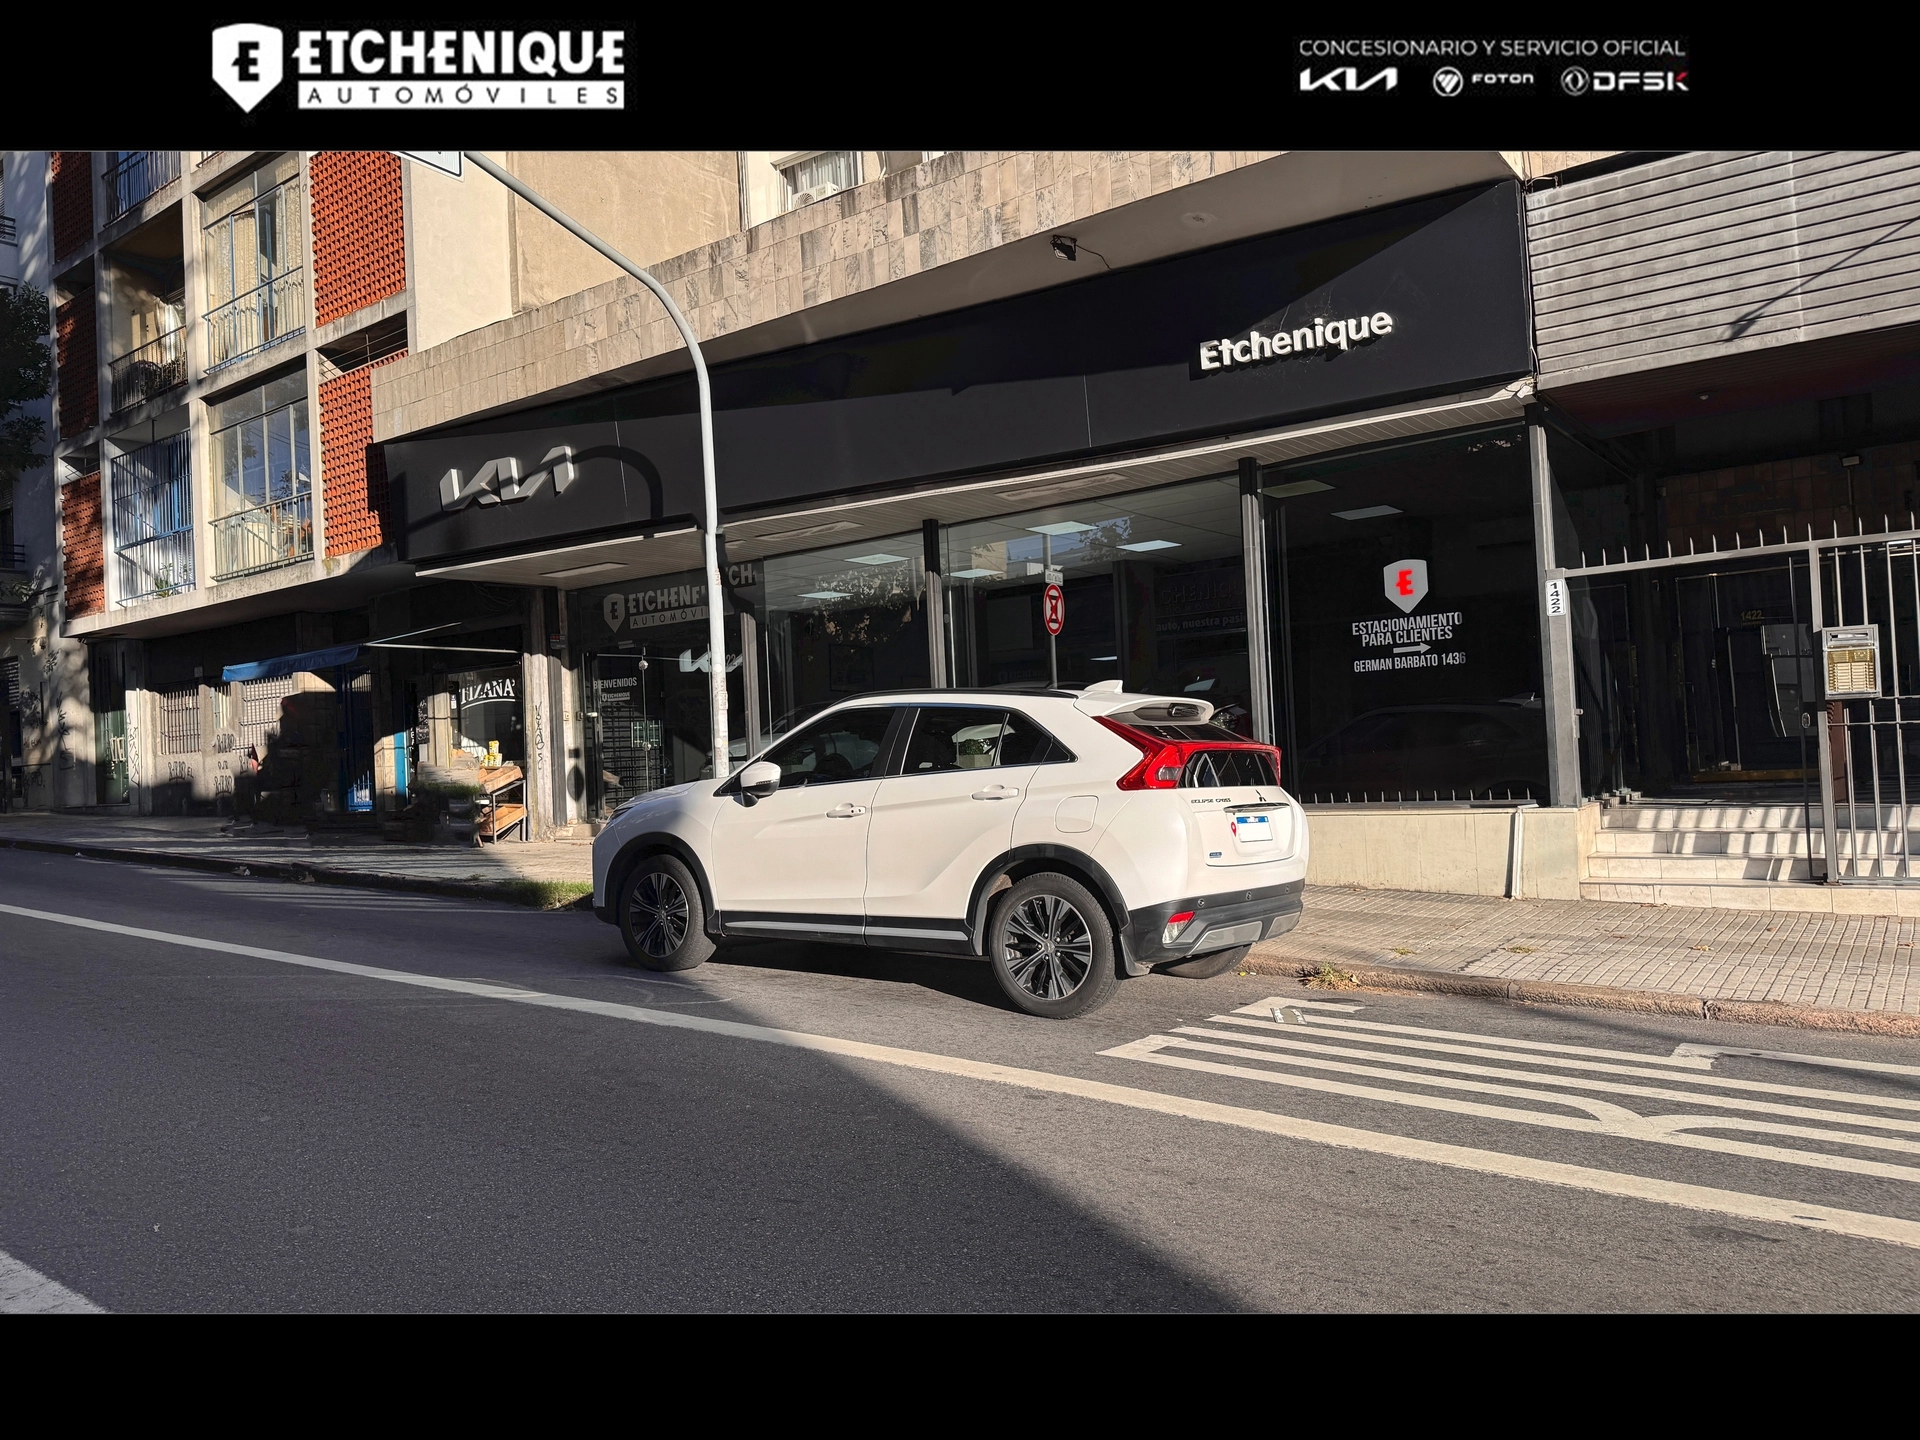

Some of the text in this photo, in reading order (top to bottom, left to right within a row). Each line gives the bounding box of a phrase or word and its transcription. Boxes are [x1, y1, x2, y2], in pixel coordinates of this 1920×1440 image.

[1199, 312, 1393, 370] Etchenique
[439, 445, 575, 512] KIA
[1550, 582, 1561, 614] 1422
[1182, 616, 1220, 629] nuestra
[1352, 611, 1463, 636] ESTACIONAMIENTO
[1741, 610, 1763, 621] 1422
[1361, 625, 1453, 647] PARA CLIENTES
[1353, 651, 1466, 673] GERMAN BARBATO 1436
[593, 676, 637, 690] BIENVENIDOS
